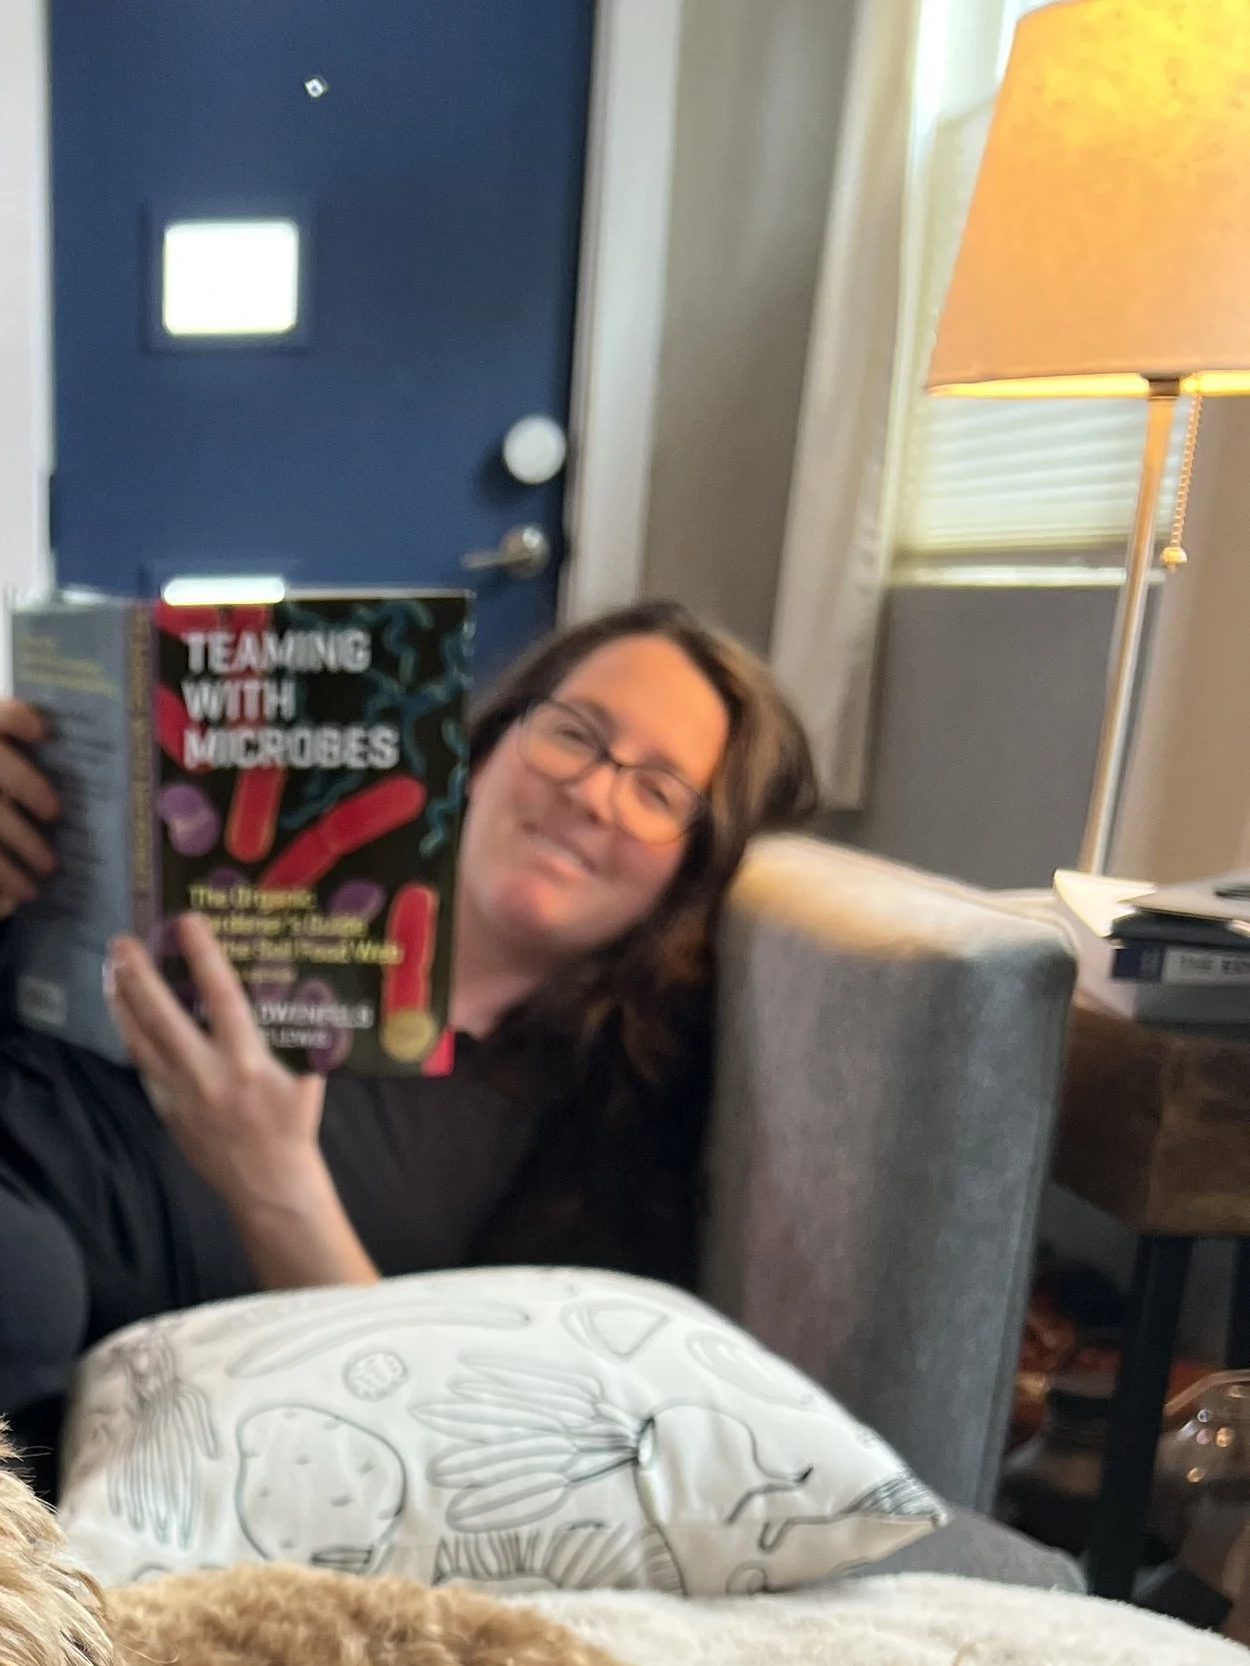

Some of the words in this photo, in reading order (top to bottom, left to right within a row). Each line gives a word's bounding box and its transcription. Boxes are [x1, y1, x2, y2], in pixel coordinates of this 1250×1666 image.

[182, 627, 372, 673] TEAMING
[181, 677, 296, 721] WITH
[183, 724, 400, 770] MICROBES
